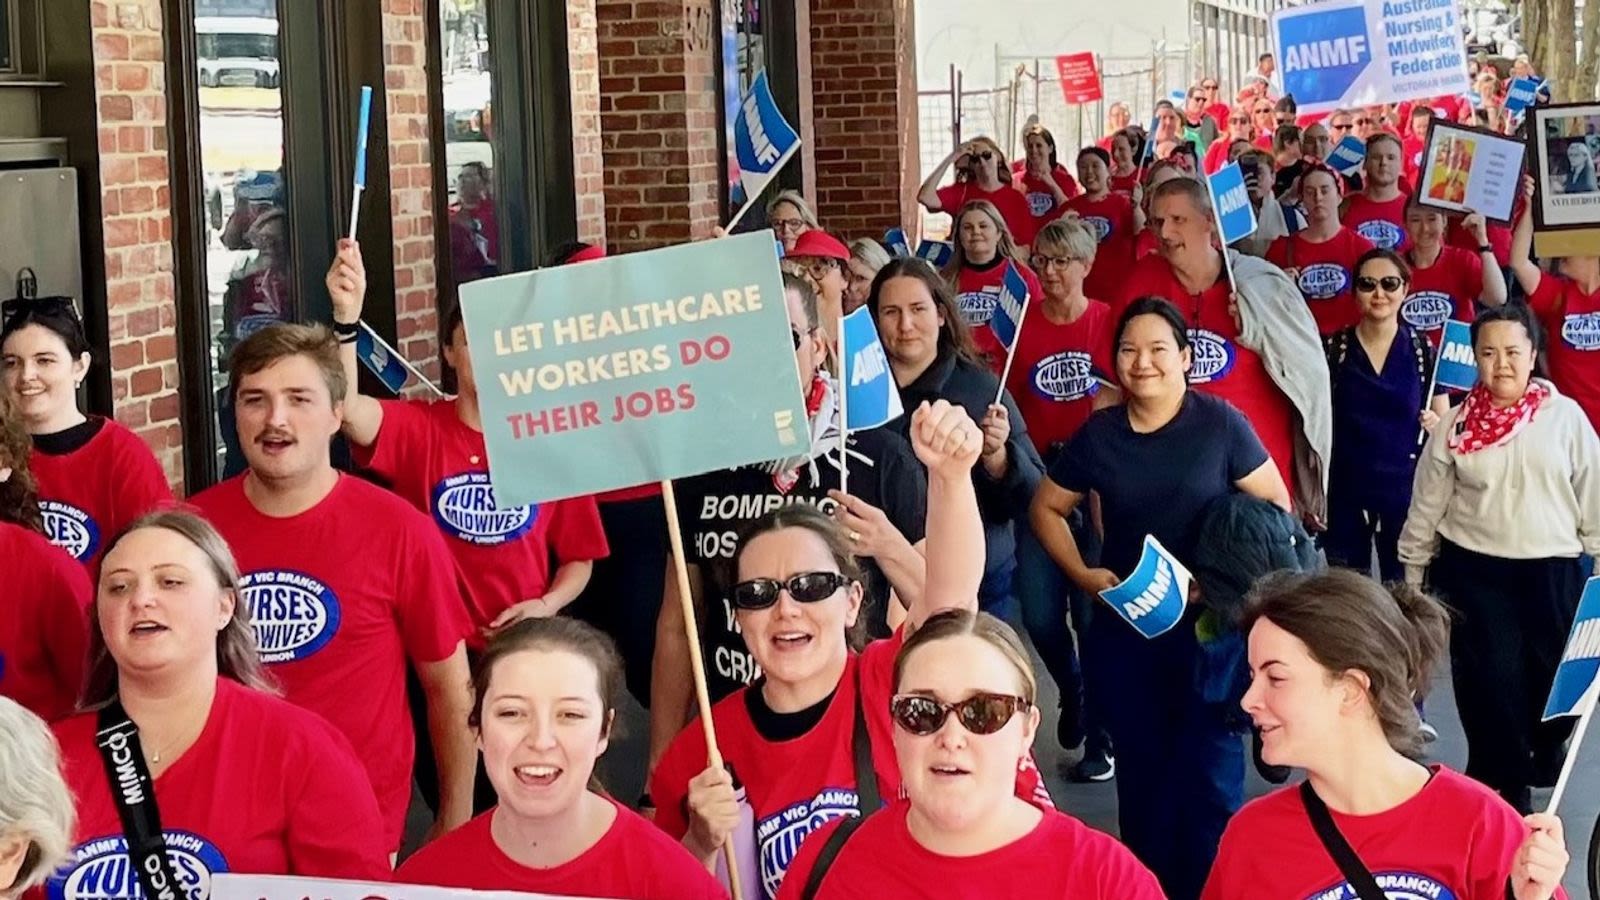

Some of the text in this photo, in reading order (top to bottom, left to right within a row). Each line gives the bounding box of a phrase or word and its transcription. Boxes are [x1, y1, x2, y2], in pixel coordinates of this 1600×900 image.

[1386, 12, 1454, 37] Nursing &
[1285, 35, 1366, 72] ANMF
[1389, 34, 1456, 57] Midwifery
[1392, 53, 1462, 76] Federation
[743, 93, 780, 166] ANMF
[1219, 181, 1250, 217] ANM
[1302, 269, 1342, 284] NURSES
[959, 297, 996, 310] URSES
[1405, 298, 1449, 314] NURSES
[494, 284, 763, 356] LET HEALTHCARE
[1196, 340, 1223, 359] SES
[1441, 341, 1478, 368] ANM
[498, 335, 732, 401] WORKERS DO
[1189, 360, 1222, 374] WIVES
[506, 382, 696, 441] THEIR JOBS
[446, 486, 524, 512] NURS
[48, 502, 89, 523] BRANCH
[445, 506, 524, 534] MIDWIVES
[46, 515, 82, 541] SES
[254, 572, 276, 584] VIC
[276, 572, 326, 600] BRANCH
[1122, 555, 1172, 621] ANMF
[243, 588, 318, 622] URSES
[251, 623, 317, 649] DWIVES
[715, 646, 763, 687] CRI
[783, 805, 809, 822] VIC
[75, 838, 121, 863] ANMF
[1375, 876, 1441, 900] BRANCH
